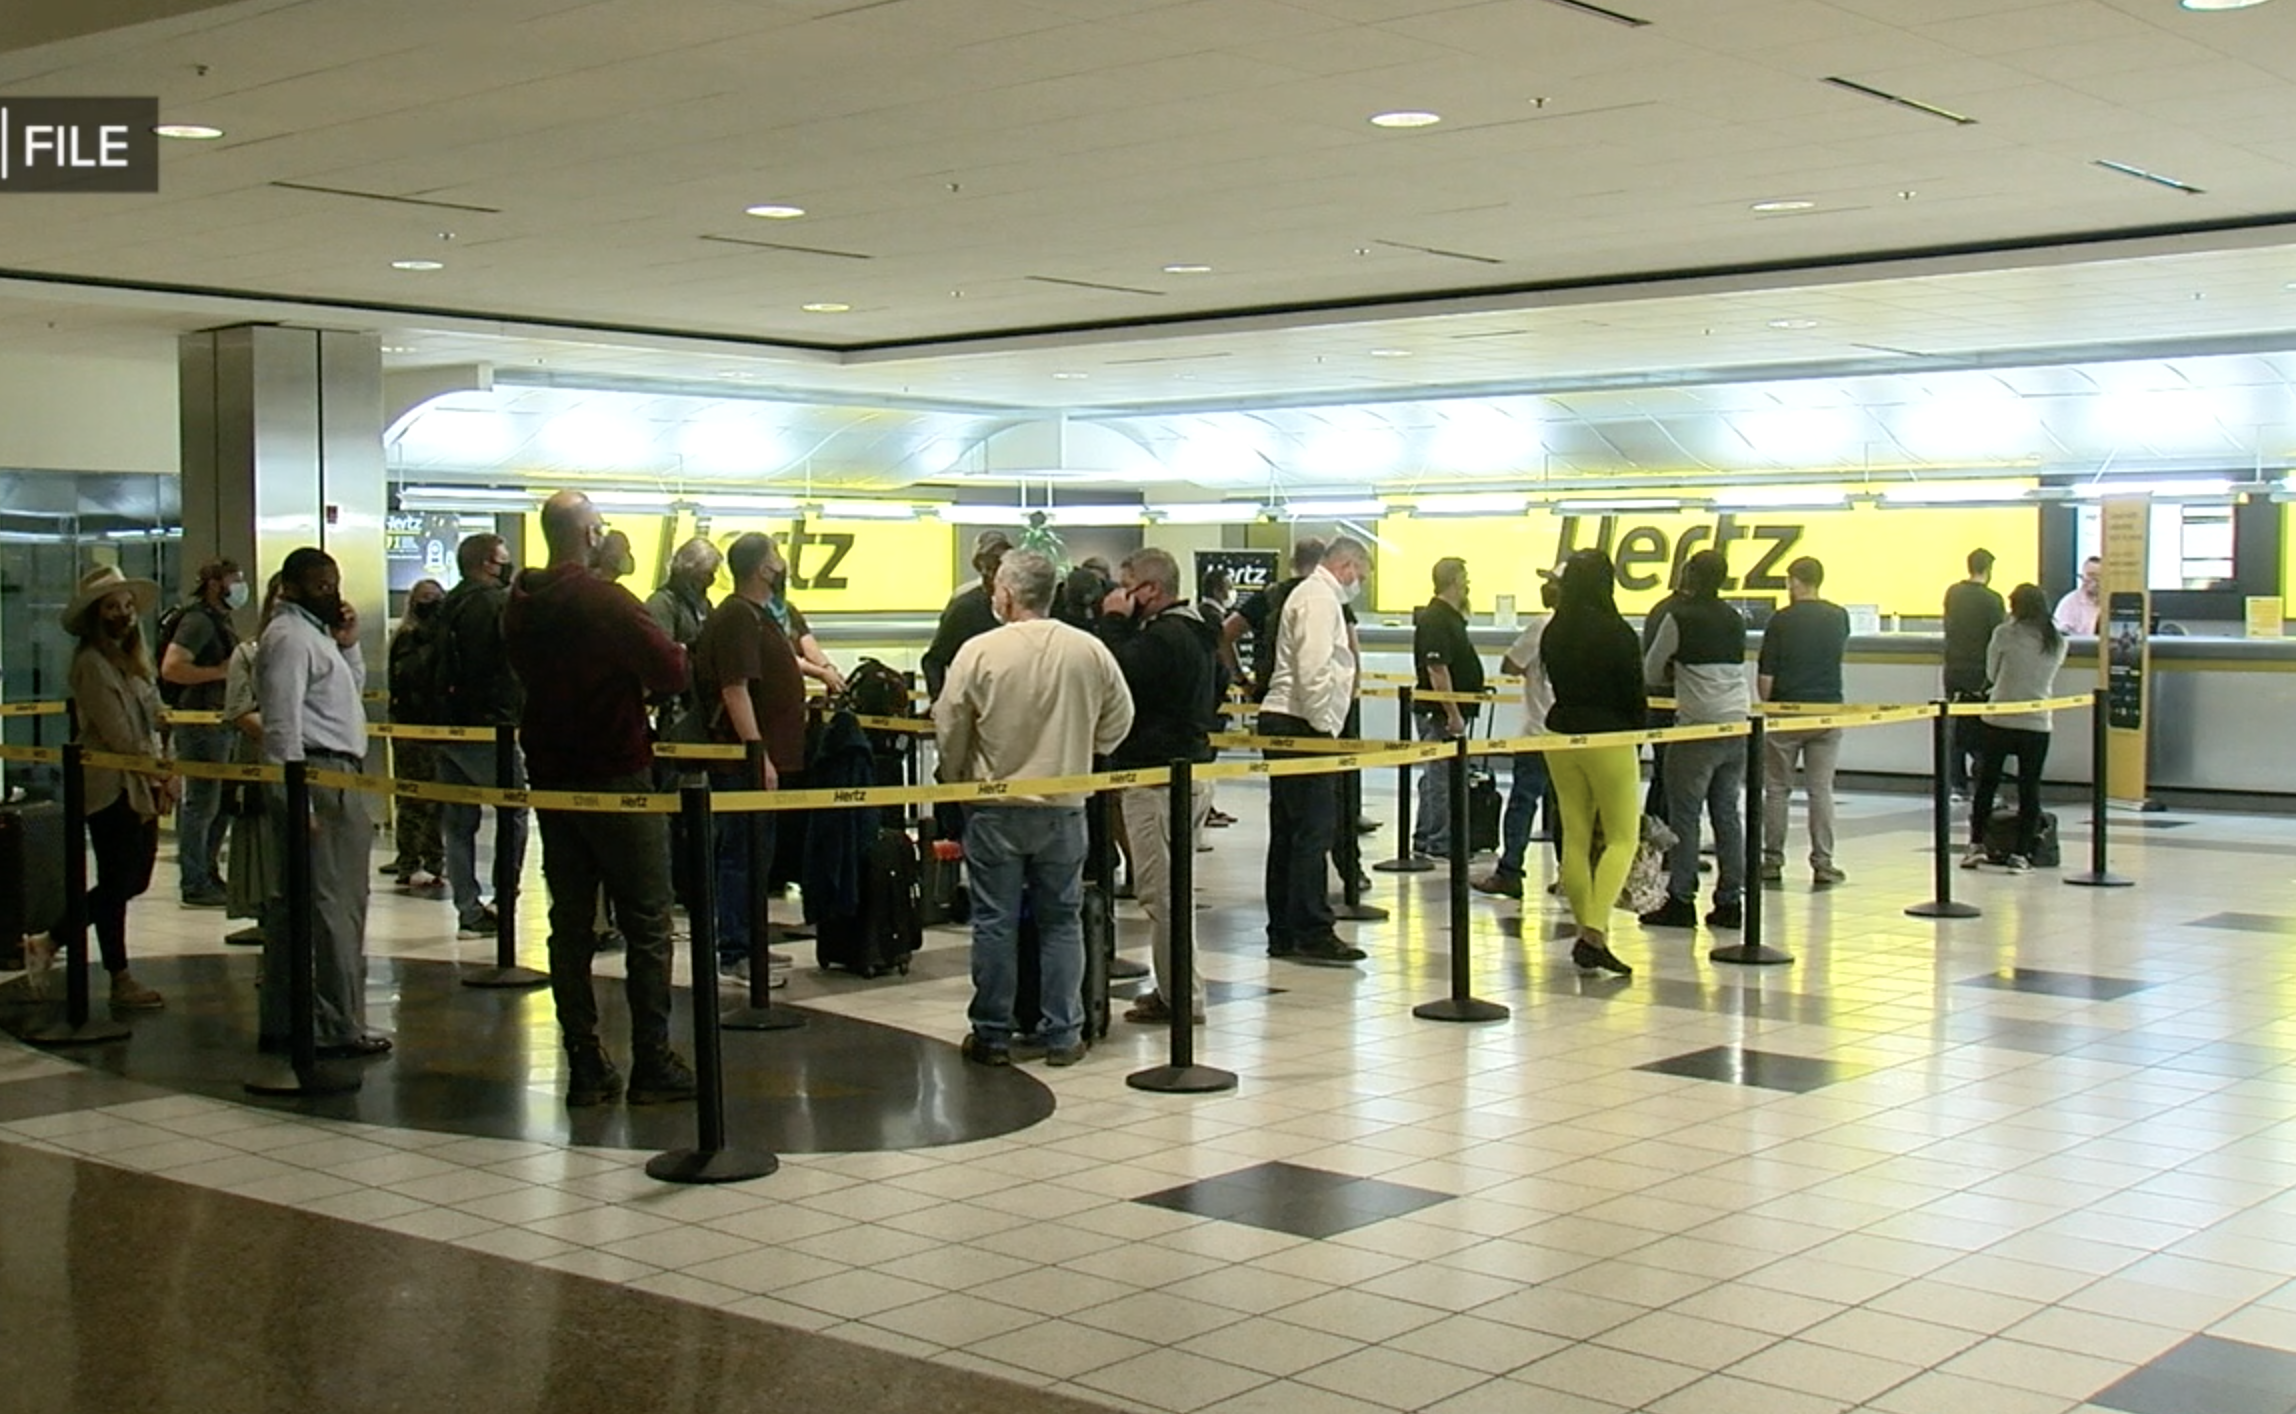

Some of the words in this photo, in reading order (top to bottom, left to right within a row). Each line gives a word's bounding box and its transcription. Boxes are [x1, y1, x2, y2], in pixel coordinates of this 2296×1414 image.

[977, 783, 1008, 795] Hertz
[620, 795, 648, 807] Hertz
[833, 789, 867, 802] Hertz
